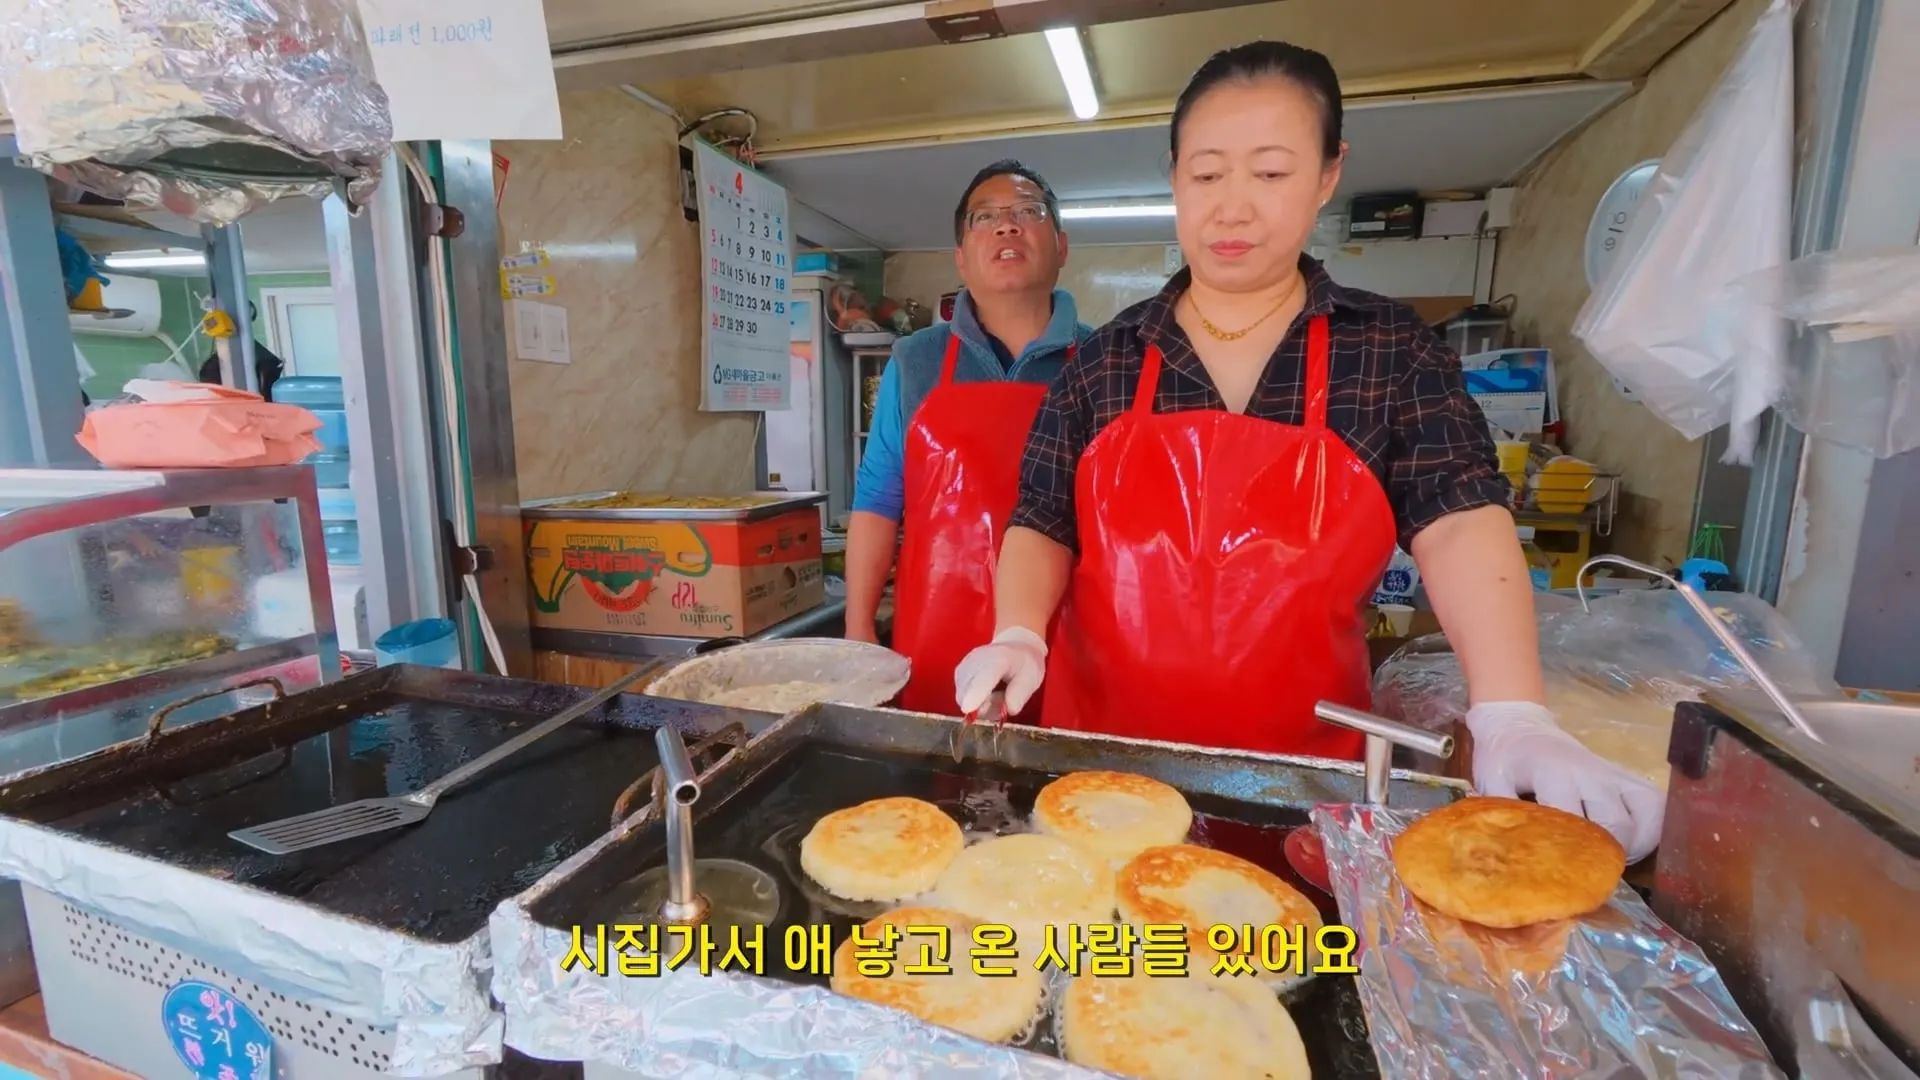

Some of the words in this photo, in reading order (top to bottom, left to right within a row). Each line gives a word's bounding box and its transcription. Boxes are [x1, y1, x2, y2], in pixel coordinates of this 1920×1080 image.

[432, 16, 492, 44] 1,000원
[735, 172, 743, 194] 4
[749, 221, 755, 234] 2
[763, 225, 770, 238] 3
[777, 229, 783, 241] 4
[736, 242, 741, 255] 8
[749, 246, 755, 258] 9
[761, 249, 771, 262] 10
[776, 253, 785, 266] 11
[711, 257, 718, 273] 12
[735, 268, 744, 282] 15
[747, 271, 757, 285] 16
[761, 274, 771, 287] 17
[775, 277, 785, 290] 18
[735, 293, 744, 308] 22
[747, 296, 757, 310] 23
[761, 299, 771, 312] 24
[774, 301, 785, 314] 25
[735, 319, 744, 332] 29
[747, 321, 758, 334] 30
[568, 536, 619, 551] Mountain
